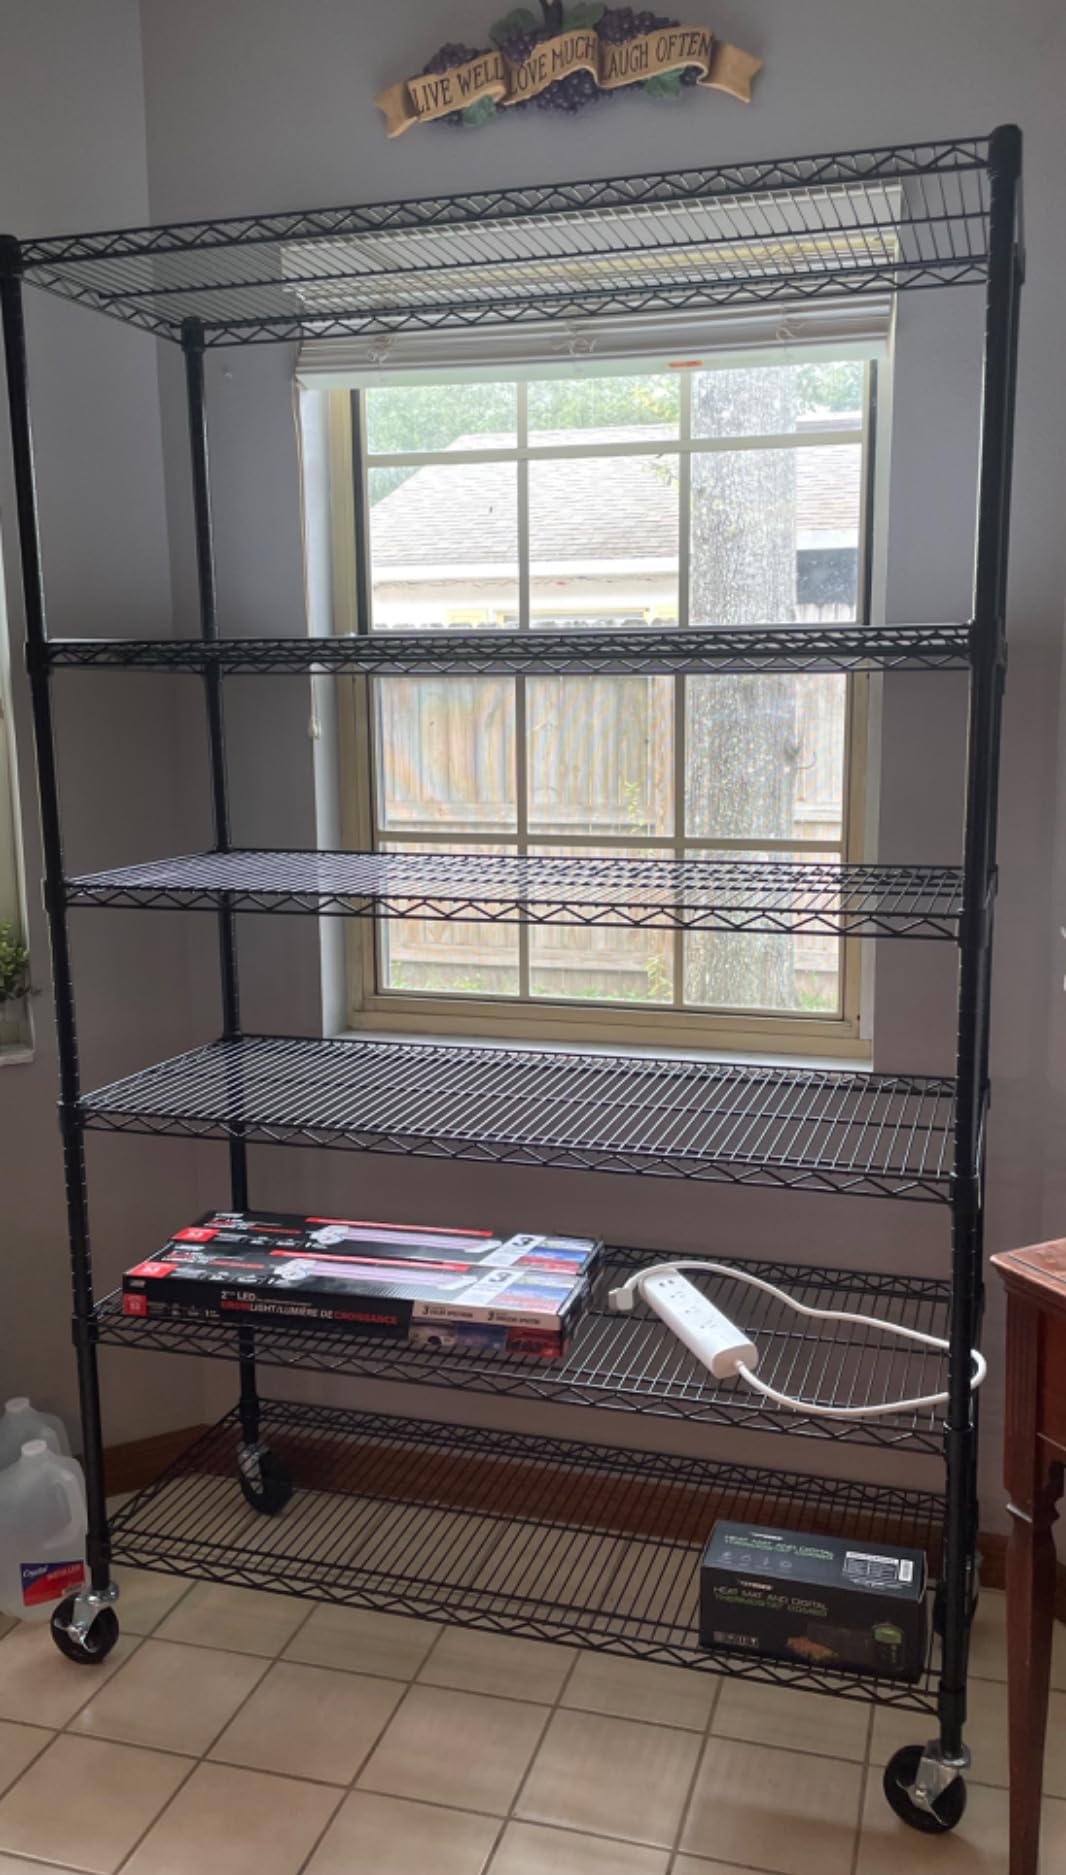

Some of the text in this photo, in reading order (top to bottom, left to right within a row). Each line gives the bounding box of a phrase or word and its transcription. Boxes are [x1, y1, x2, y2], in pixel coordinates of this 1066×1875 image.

[411, 78, 452, 114] LIVE
[456, 55, 505, 97] WELL
[509, 53, 548, 95] LOVE
[551, 35, 597, 73] MUCH
[655, 31, 714, 63] OFTEN
